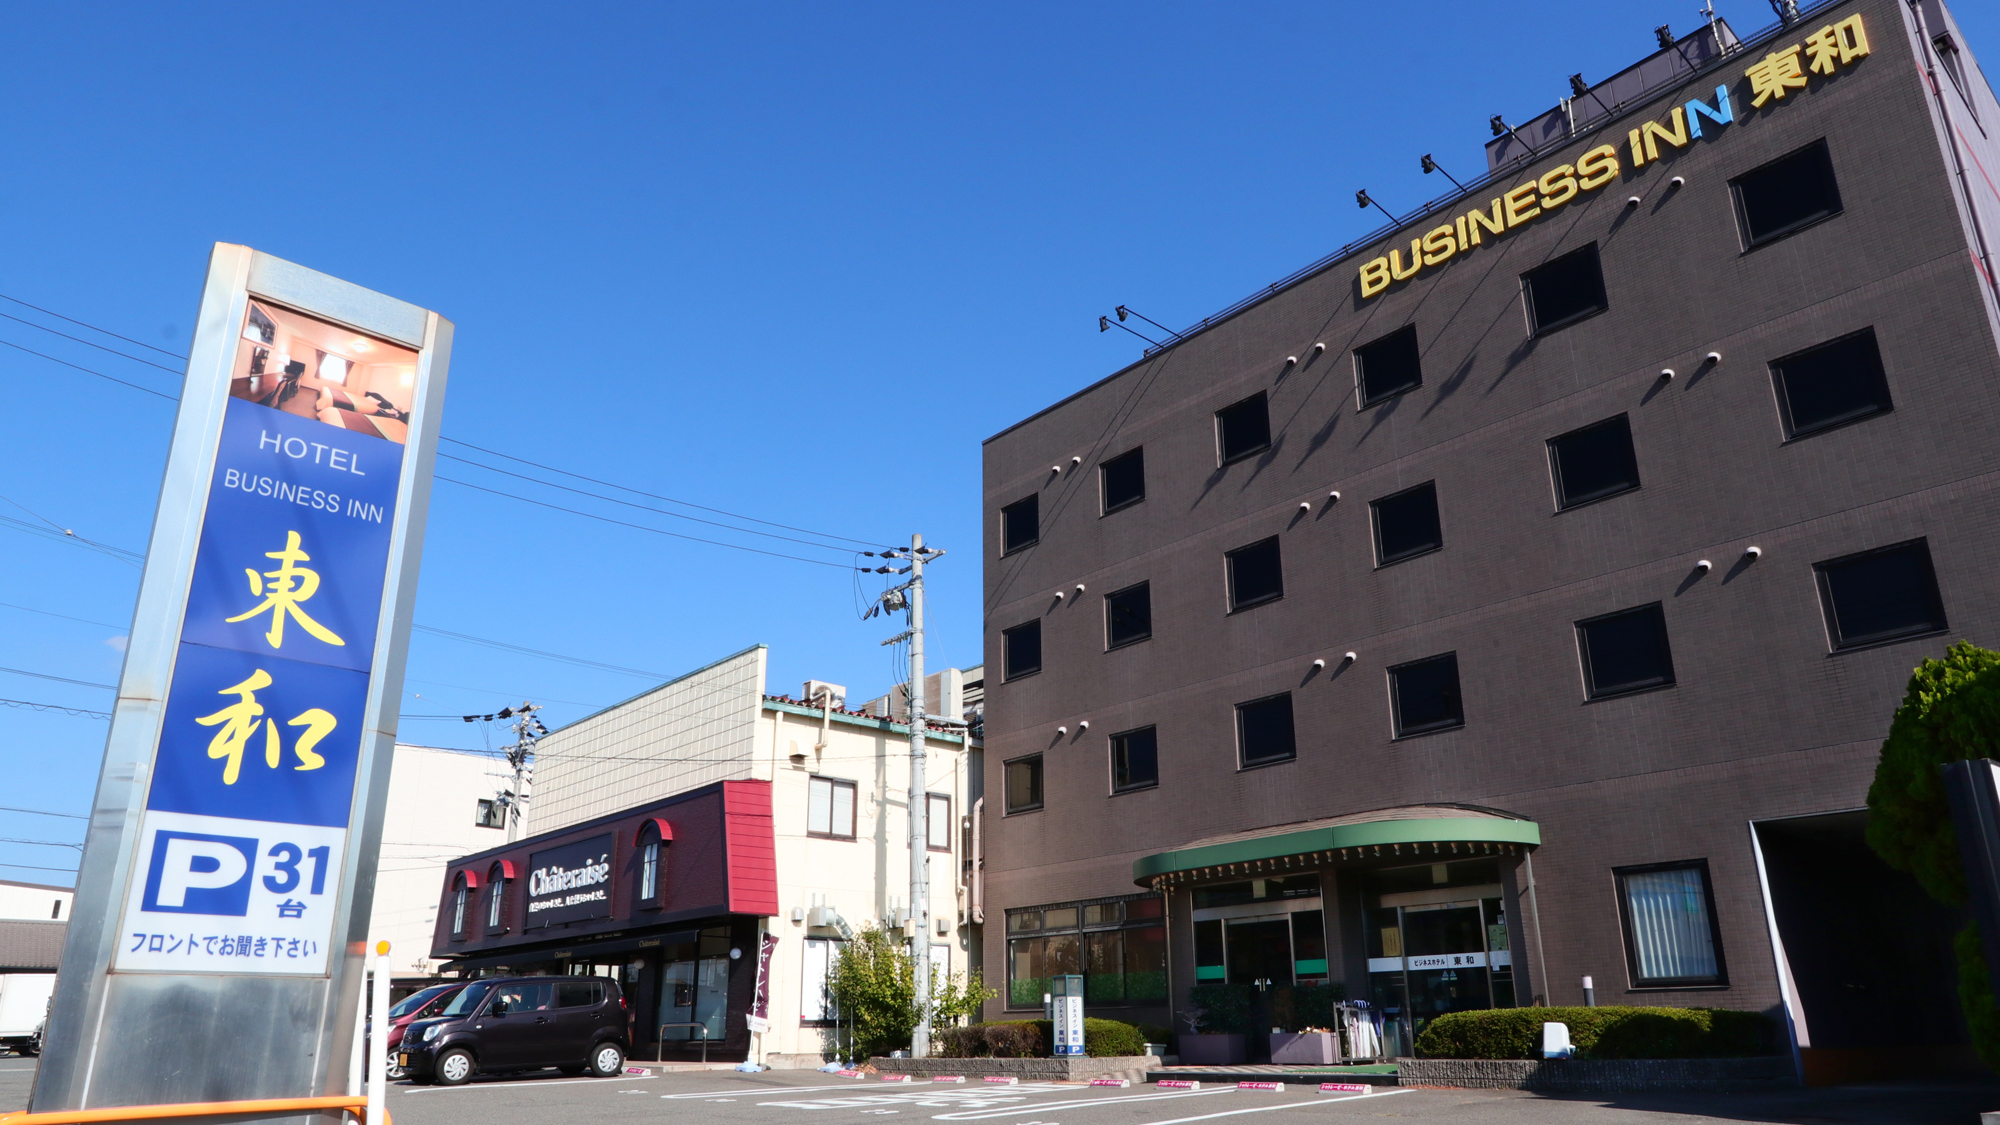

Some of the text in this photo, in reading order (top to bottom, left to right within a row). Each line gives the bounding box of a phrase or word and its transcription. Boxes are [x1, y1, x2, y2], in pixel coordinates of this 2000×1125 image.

[1359, 13, 1870, 299] BUSINESS INN 東和
[259, 429, 366, 476] HOTEL
[224, 468, 384, 524] BUSINESS INN
[195, 530, 345, 785] 東和
[156, 837, 248, 908] P
[262, 841, 331, 896] 31
[529, 853, 610, 897] Châteraisé
[276, 899, 308, 919] 台
[130, 932, 318, 959] フロントでお聞き下さい
[1414, 956, 1475, 967] ビジネスホテル 東和
